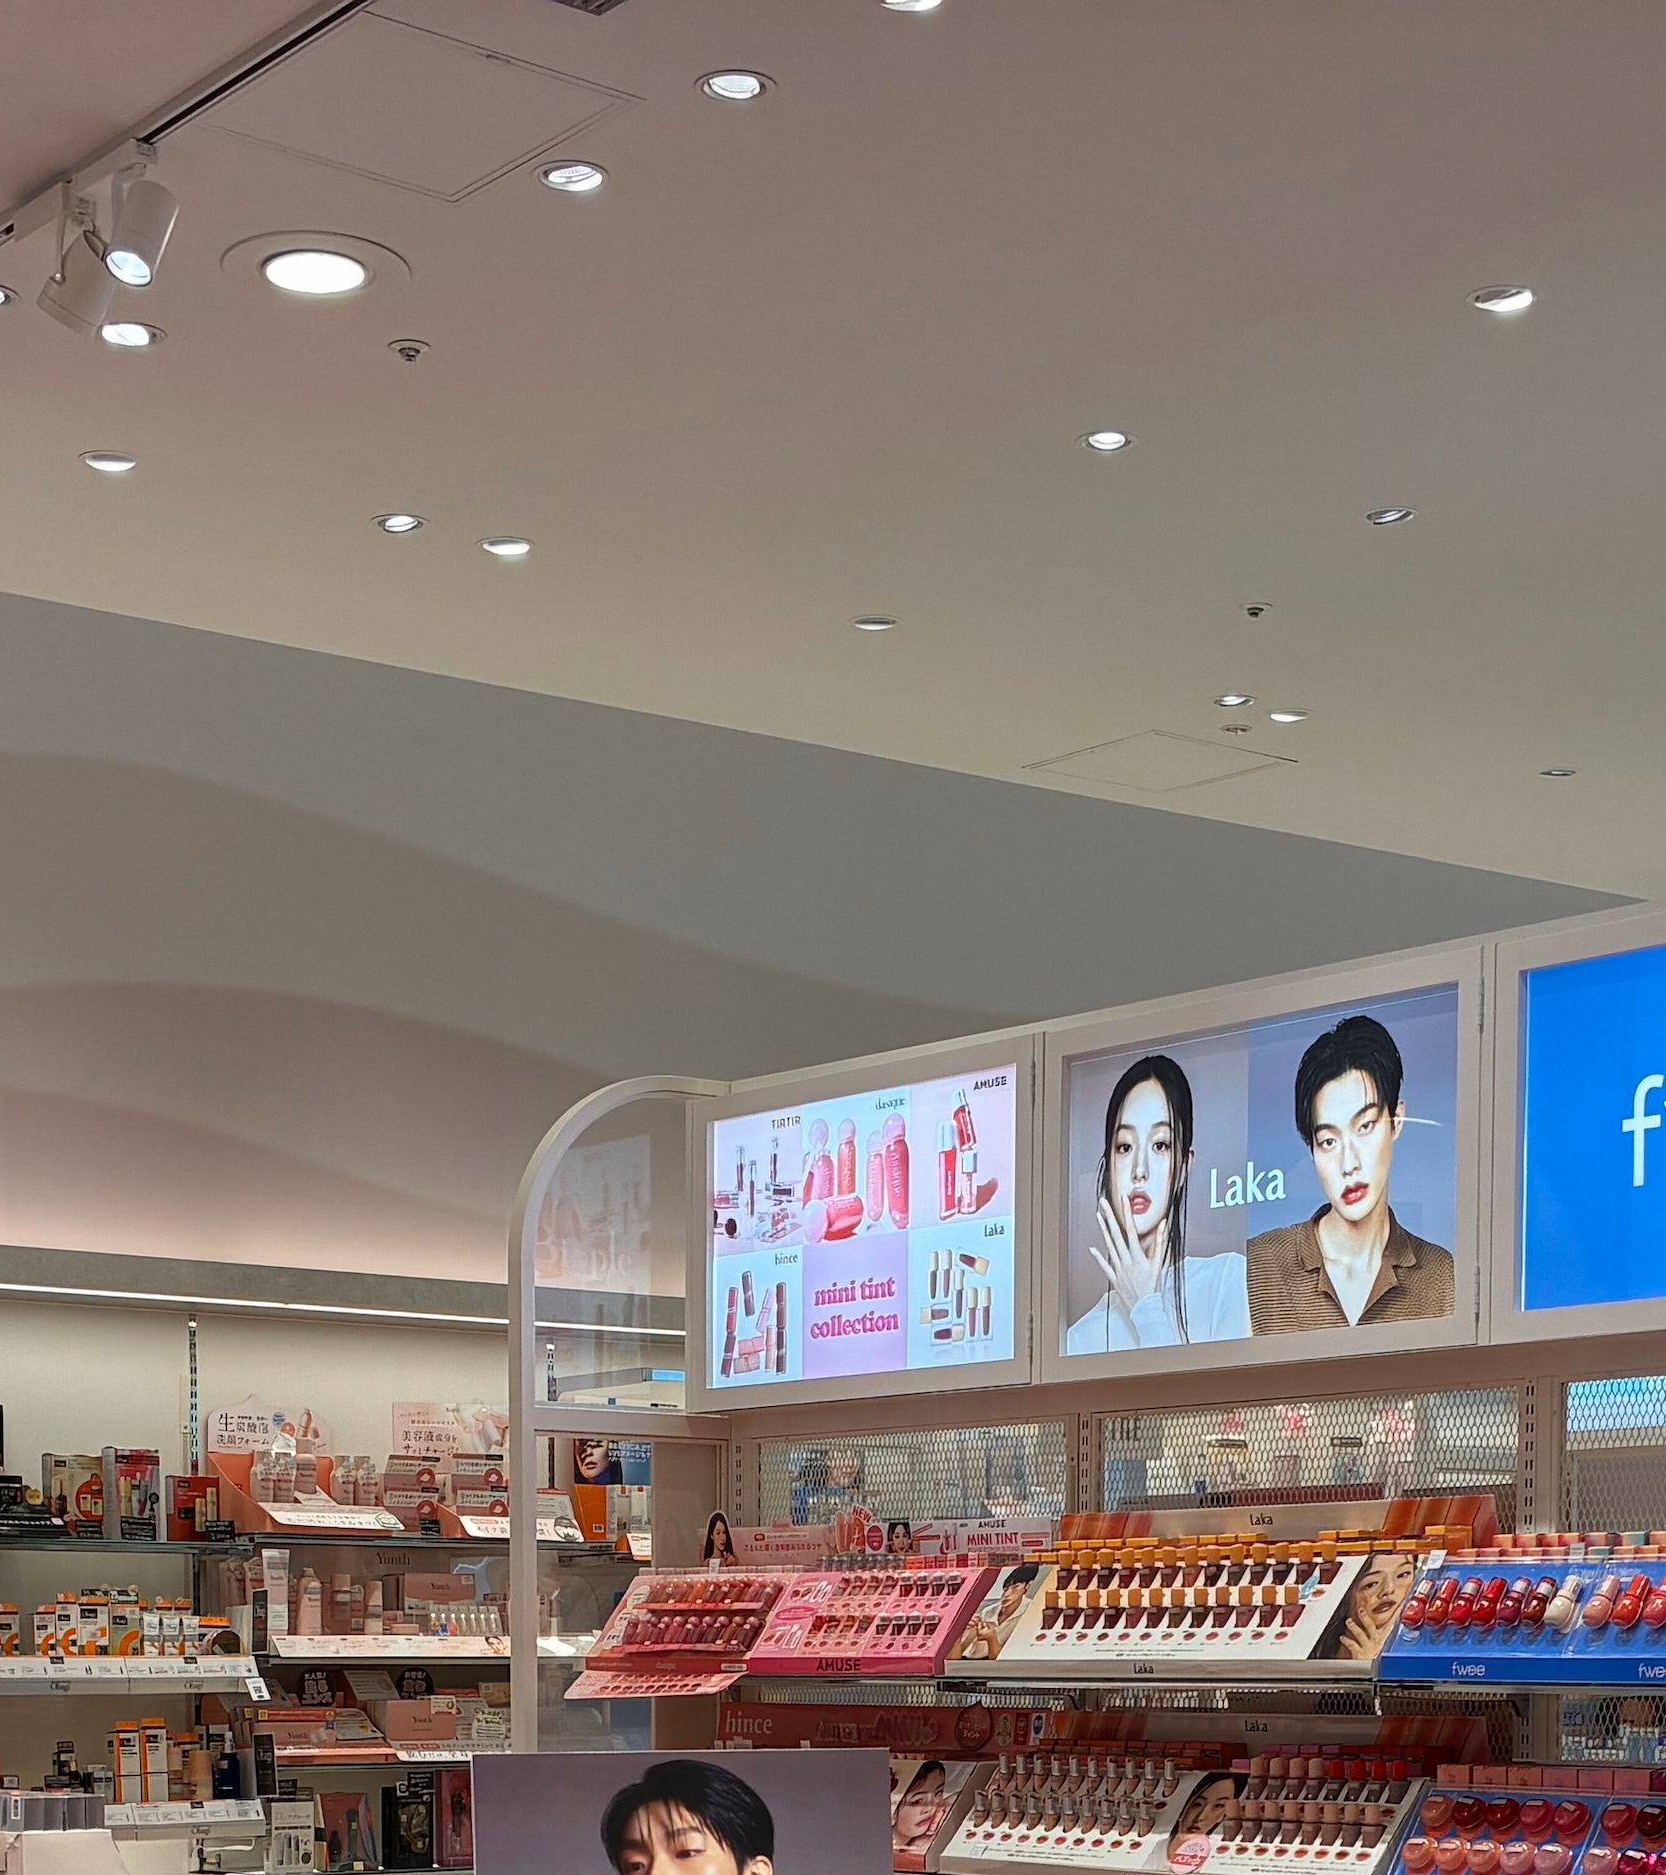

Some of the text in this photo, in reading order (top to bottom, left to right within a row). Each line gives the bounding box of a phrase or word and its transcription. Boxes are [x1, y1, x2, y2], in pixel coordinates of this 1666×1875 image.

[973, 1076, 1007, 1091] AMUSE
[1209, 1161, 1286, 1209] Laka
[984, 1224, 1005, 1237] Laka
[814, 1276, 896, 1306] mini tint
[810, 1310, 899, 1339] collection
[1250, 1513, 1273, 1526] Laka
[967, 1532, 1019, 1545] MINI TINT
[816, 1658, 861, 1671] AMUSE
[1451, 1662, 1486, 1679] fwee
[725, 1711, 773, 1735] hince
[1245, 1719, 1269, 1732] Laka
